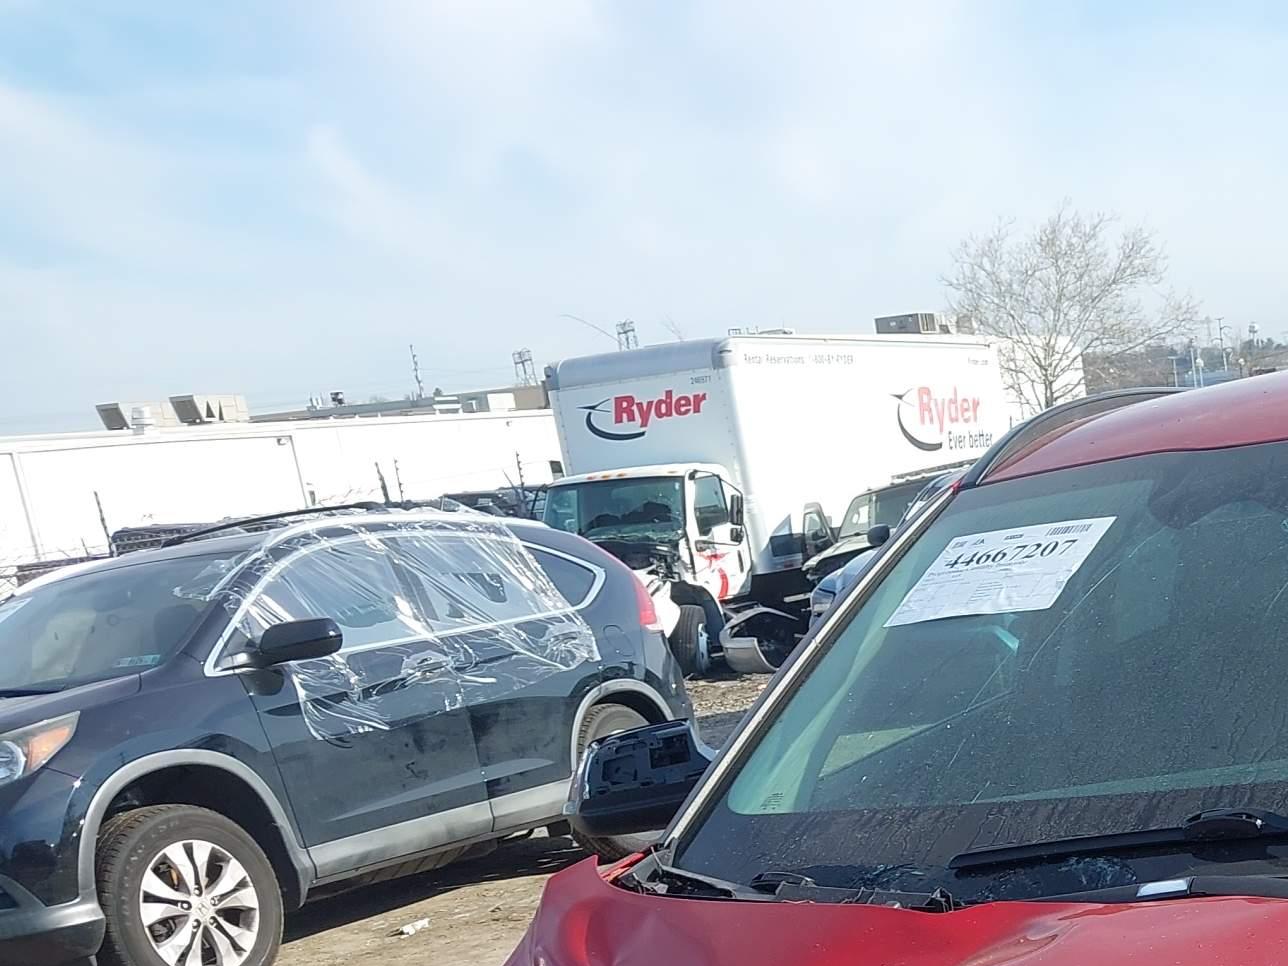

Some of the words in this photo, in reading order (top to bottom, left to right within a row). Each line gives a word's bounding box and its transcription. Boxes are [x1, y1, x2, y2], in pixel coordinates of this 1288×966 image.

[614, 389, 707, 428] Ryder
[917, 385, 980, 434] Ryder
[948, 431, 967, 450] Ever
[968, 429, 993, 448] better
[944, 539, 1079, 569] 44667207
